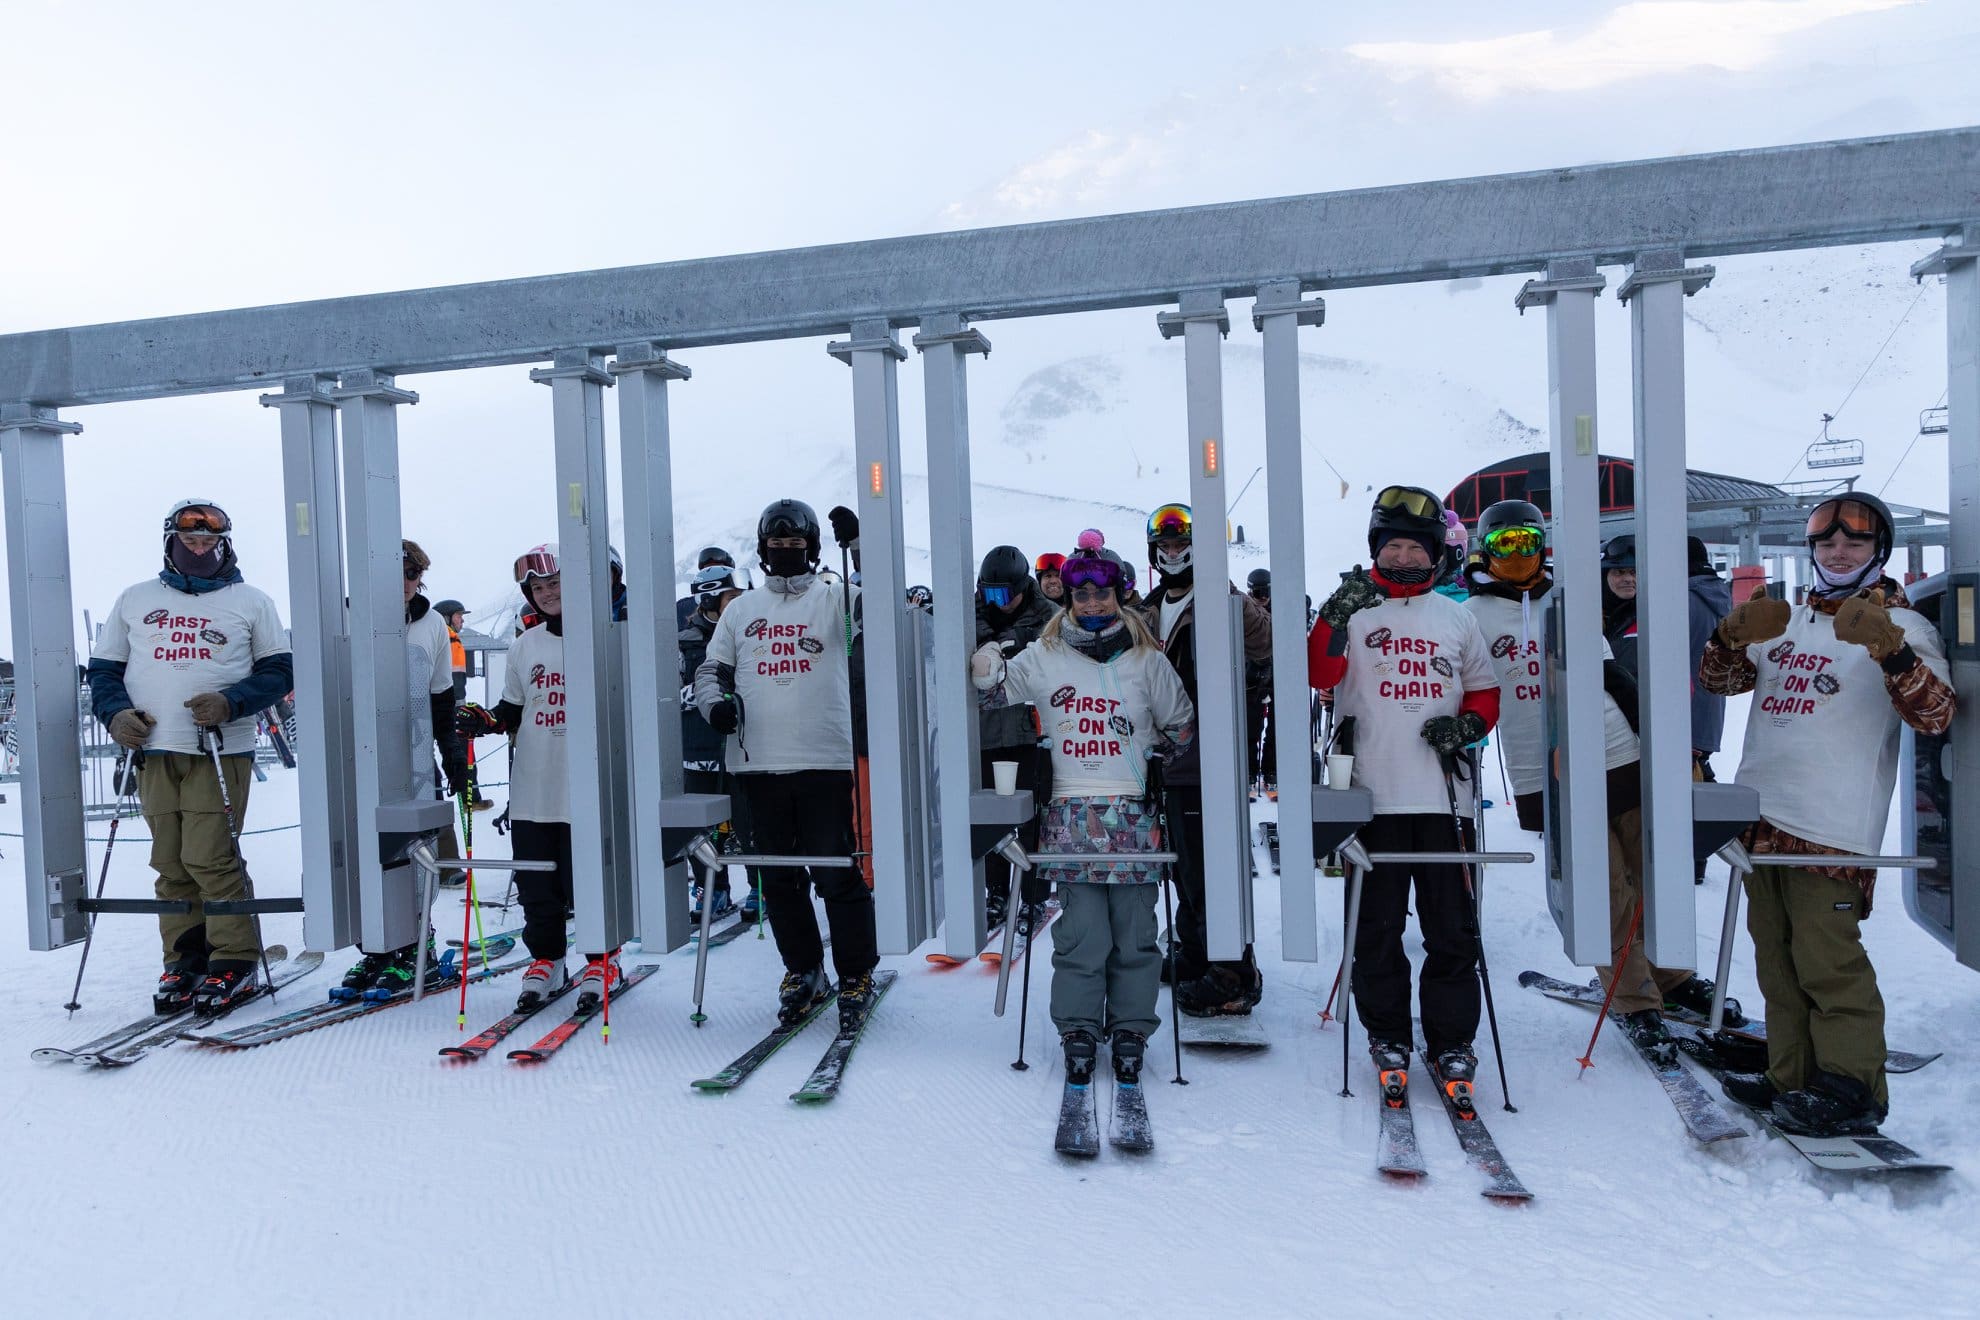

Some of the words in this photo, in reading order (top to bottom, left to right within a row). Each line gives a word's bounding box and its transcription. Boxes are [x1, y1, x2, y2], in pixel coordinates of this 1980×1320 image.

[158, 616, 211, 629] FIRST
[171, 631, 196, 644] ON
[757, 624, 808, 641] FIRST
[154, 647, 212, 661] CHAIR
[771, 642, 796, 656] ON
[1381, 637, 1439, 656] FIRST
[757, 659, 812, 676] CHAIR
[1398, 658, 1427, 677] ON
[1528, 660, 1540, 676] O
[1779, 653, 1833, 673] FIRST
[537, 672, 566, 689] FIR
[1783, 674, 1810, 693] ON
[1379, 680, 1443, 700] CHAIR
[1064, 696, 1121, 715] FIRST
[1761, 695, 1816, 715] CHAIR
[535, 711, 566, 727] CHA
[1078, 717, 1105, 735] ON
[1062, 739, 1122, 758] CHAIR
